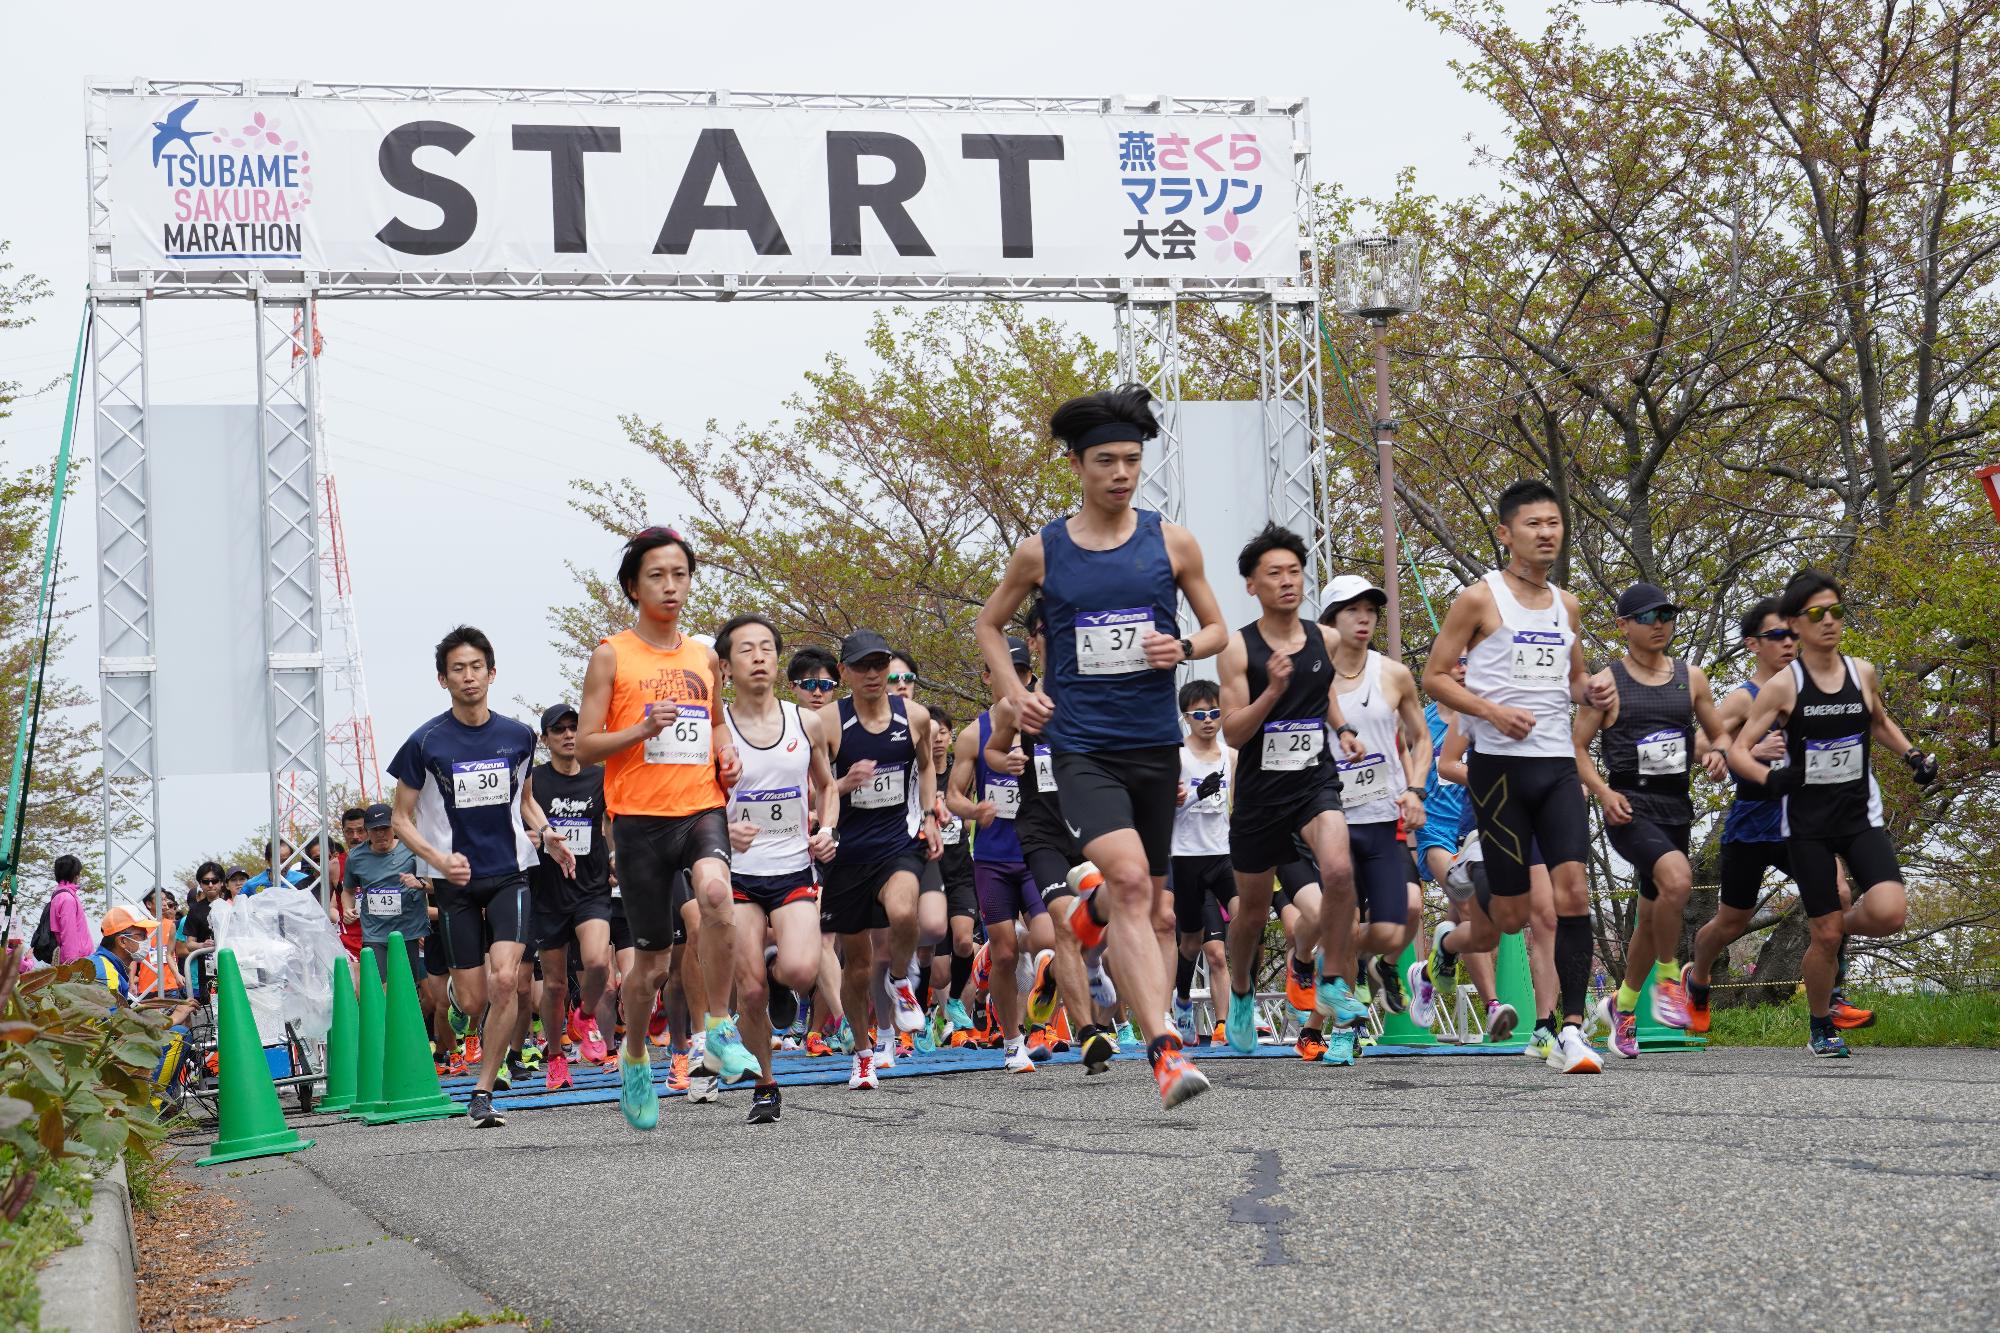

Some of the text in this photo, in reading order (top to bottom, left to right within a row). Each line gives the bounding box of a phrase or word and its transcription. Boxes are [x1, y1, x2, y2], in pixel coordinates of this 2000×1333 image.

[1118, 130, 1262, 172] 燕さくら
[162, 153, 299, 188] TSUBAME
[374, 119, 1065, 259] START
[1121, 177, 1263, 216] マラソン
[174, 188, 291, 222] SAKURA
[163, 222, 302, 252] MARATHON
[1123, 219, 1197, 260] 大会
[1082, 626, 1137, 652] A 37
[1515, 647, 1554, 667] A 25
[657, 668, 683, 679] THE
[639, 679, 687, 691] NORTH
[655, 689, 688, 701] FACE
[675, 721, 699, 742] 65
[1266, 734, 1312, 752] A 28
[1643, 742, 1676, 761] A 59
[1040, 761, 1048, 775] A
[1810, 750, 1851, 768] A 57
[458, 778, 466, 792] A
[477, 772, 498, 790] 30
[874, 775, 891, 793] 61
[1355, 768, 1375, 786] 49
[988, 790, 995, 801] A
[741, 804, 783, 821] A 8
[565, 828, 580, 842] 41
[380, 895, 393, 906] 43
